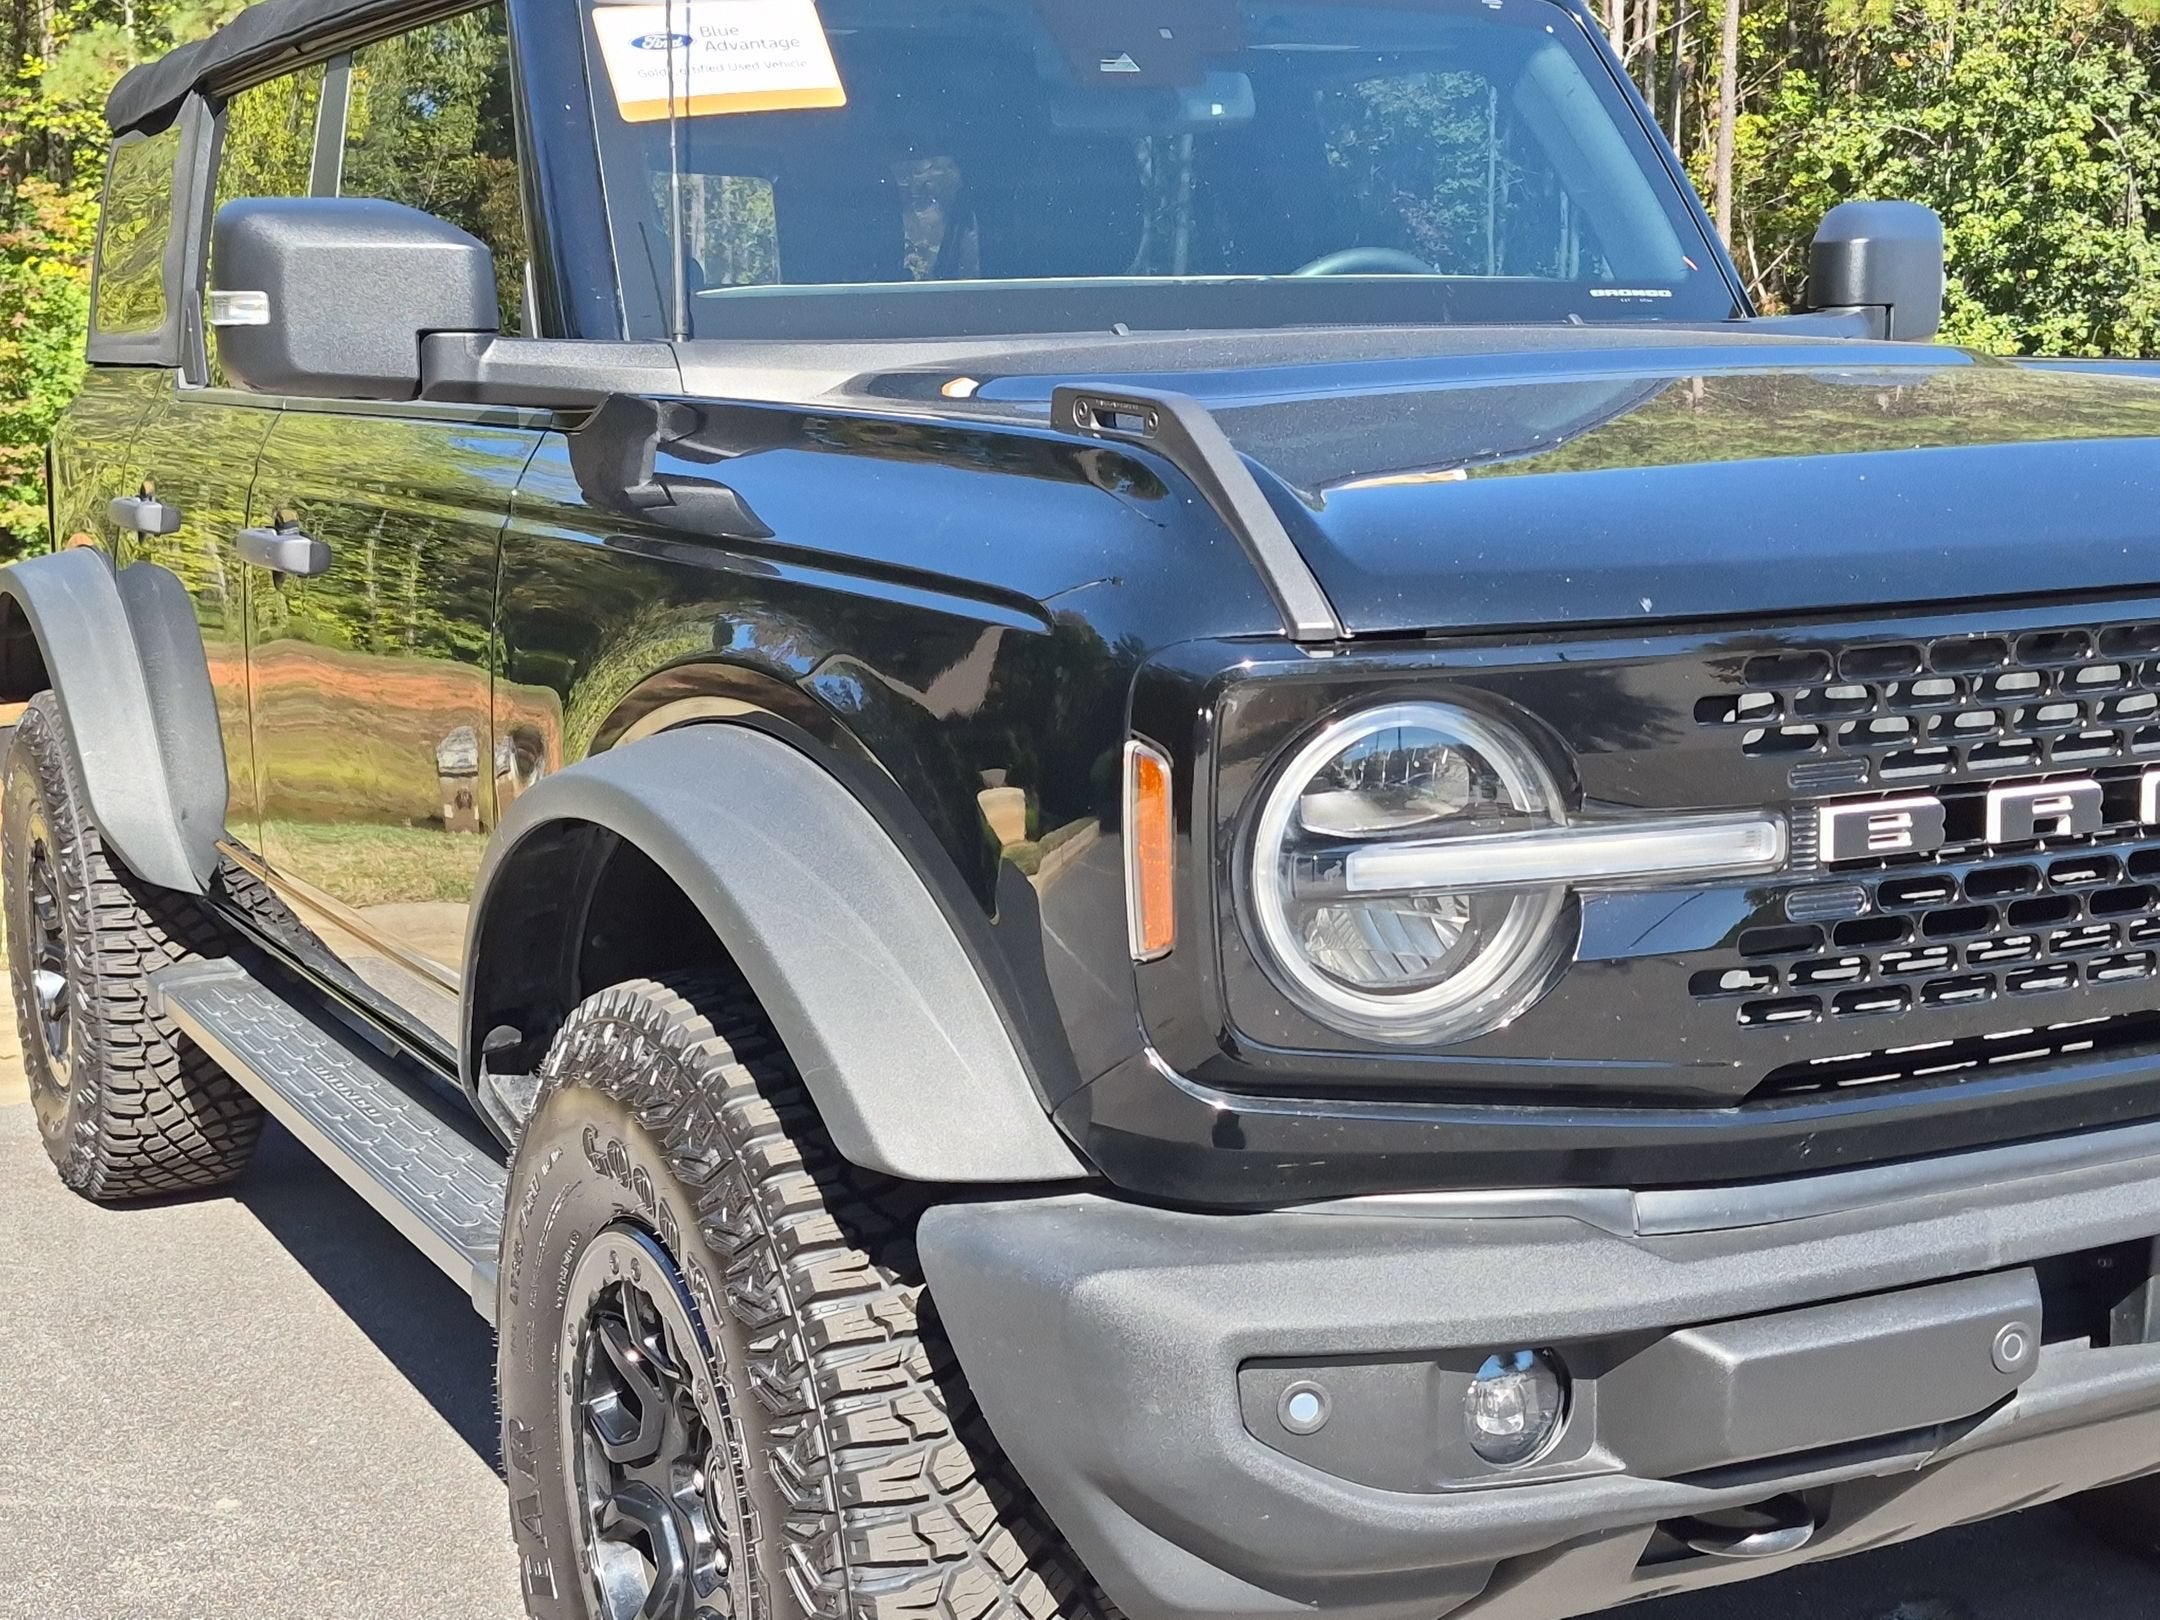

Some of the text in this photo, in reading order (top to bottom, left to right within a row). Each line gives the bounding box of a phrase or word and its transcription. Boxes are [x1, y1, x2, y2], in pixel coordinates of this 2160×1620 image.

[699, 25, 739, 38] Blue
[705, 38, 801, 52] Advantage
[637, 57, 808, 79] Gold etified Used Vehicle
[1819, 770, 2160, 863] BR
[311, 1066, 382, 1117] BRONCO
